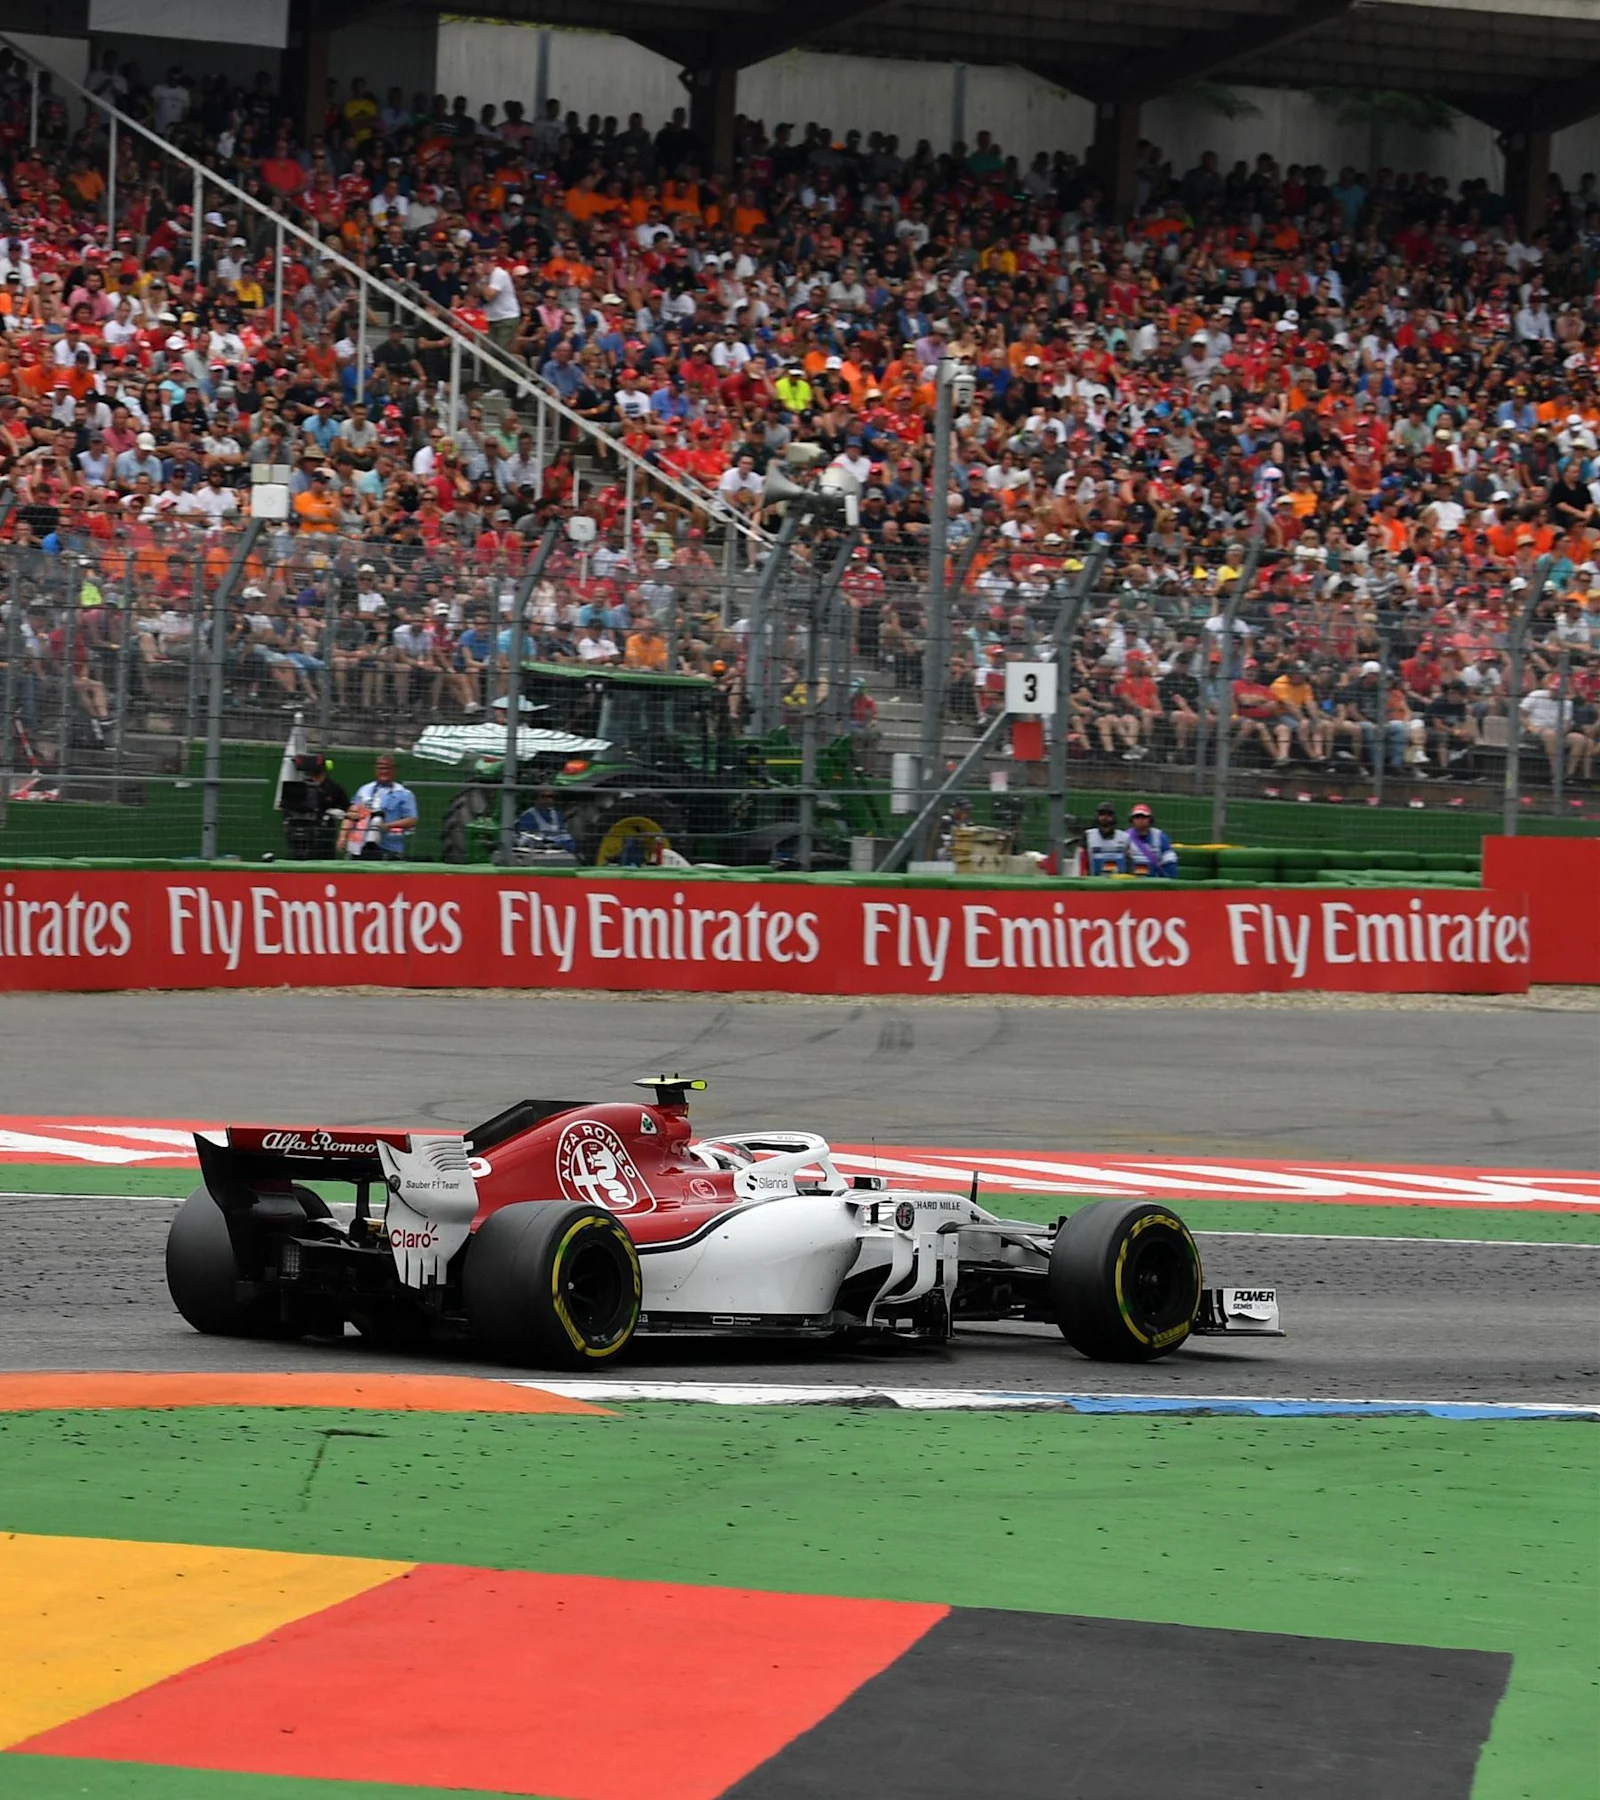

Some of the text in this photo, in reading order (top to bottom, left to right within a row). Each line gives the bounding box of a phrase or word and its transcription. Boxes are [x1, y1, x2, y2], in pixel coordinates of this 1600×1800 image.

[1024, 673, 1037, 702] 3
[167, 884, 462, 970] Fly Emirates
[499, 891, 819, 972] Fly Emirates
[1226, 898, 1529, 977] Fly Emirates
[863, 902, 1189, 981] Fly Emirates
[262, 1131, 377, 1154] Alfa Romeo
[560, 1125, 635, 1182] ALFA ROMEO
[405, 1180, 431, 1190] Sauber
[432, 1180, 440, 1190] F1
[441, 1180, 460, 1190] Team
[758, 1176, 788, 1189] Silanna
[913, 1200, 961, 1210] CHARD MILLE
[391, 1228, 432, 1249] Claro
[1130, 1214, 1181, 1239] ZERO
[1234, 1291, 1275, 1302] POWER
